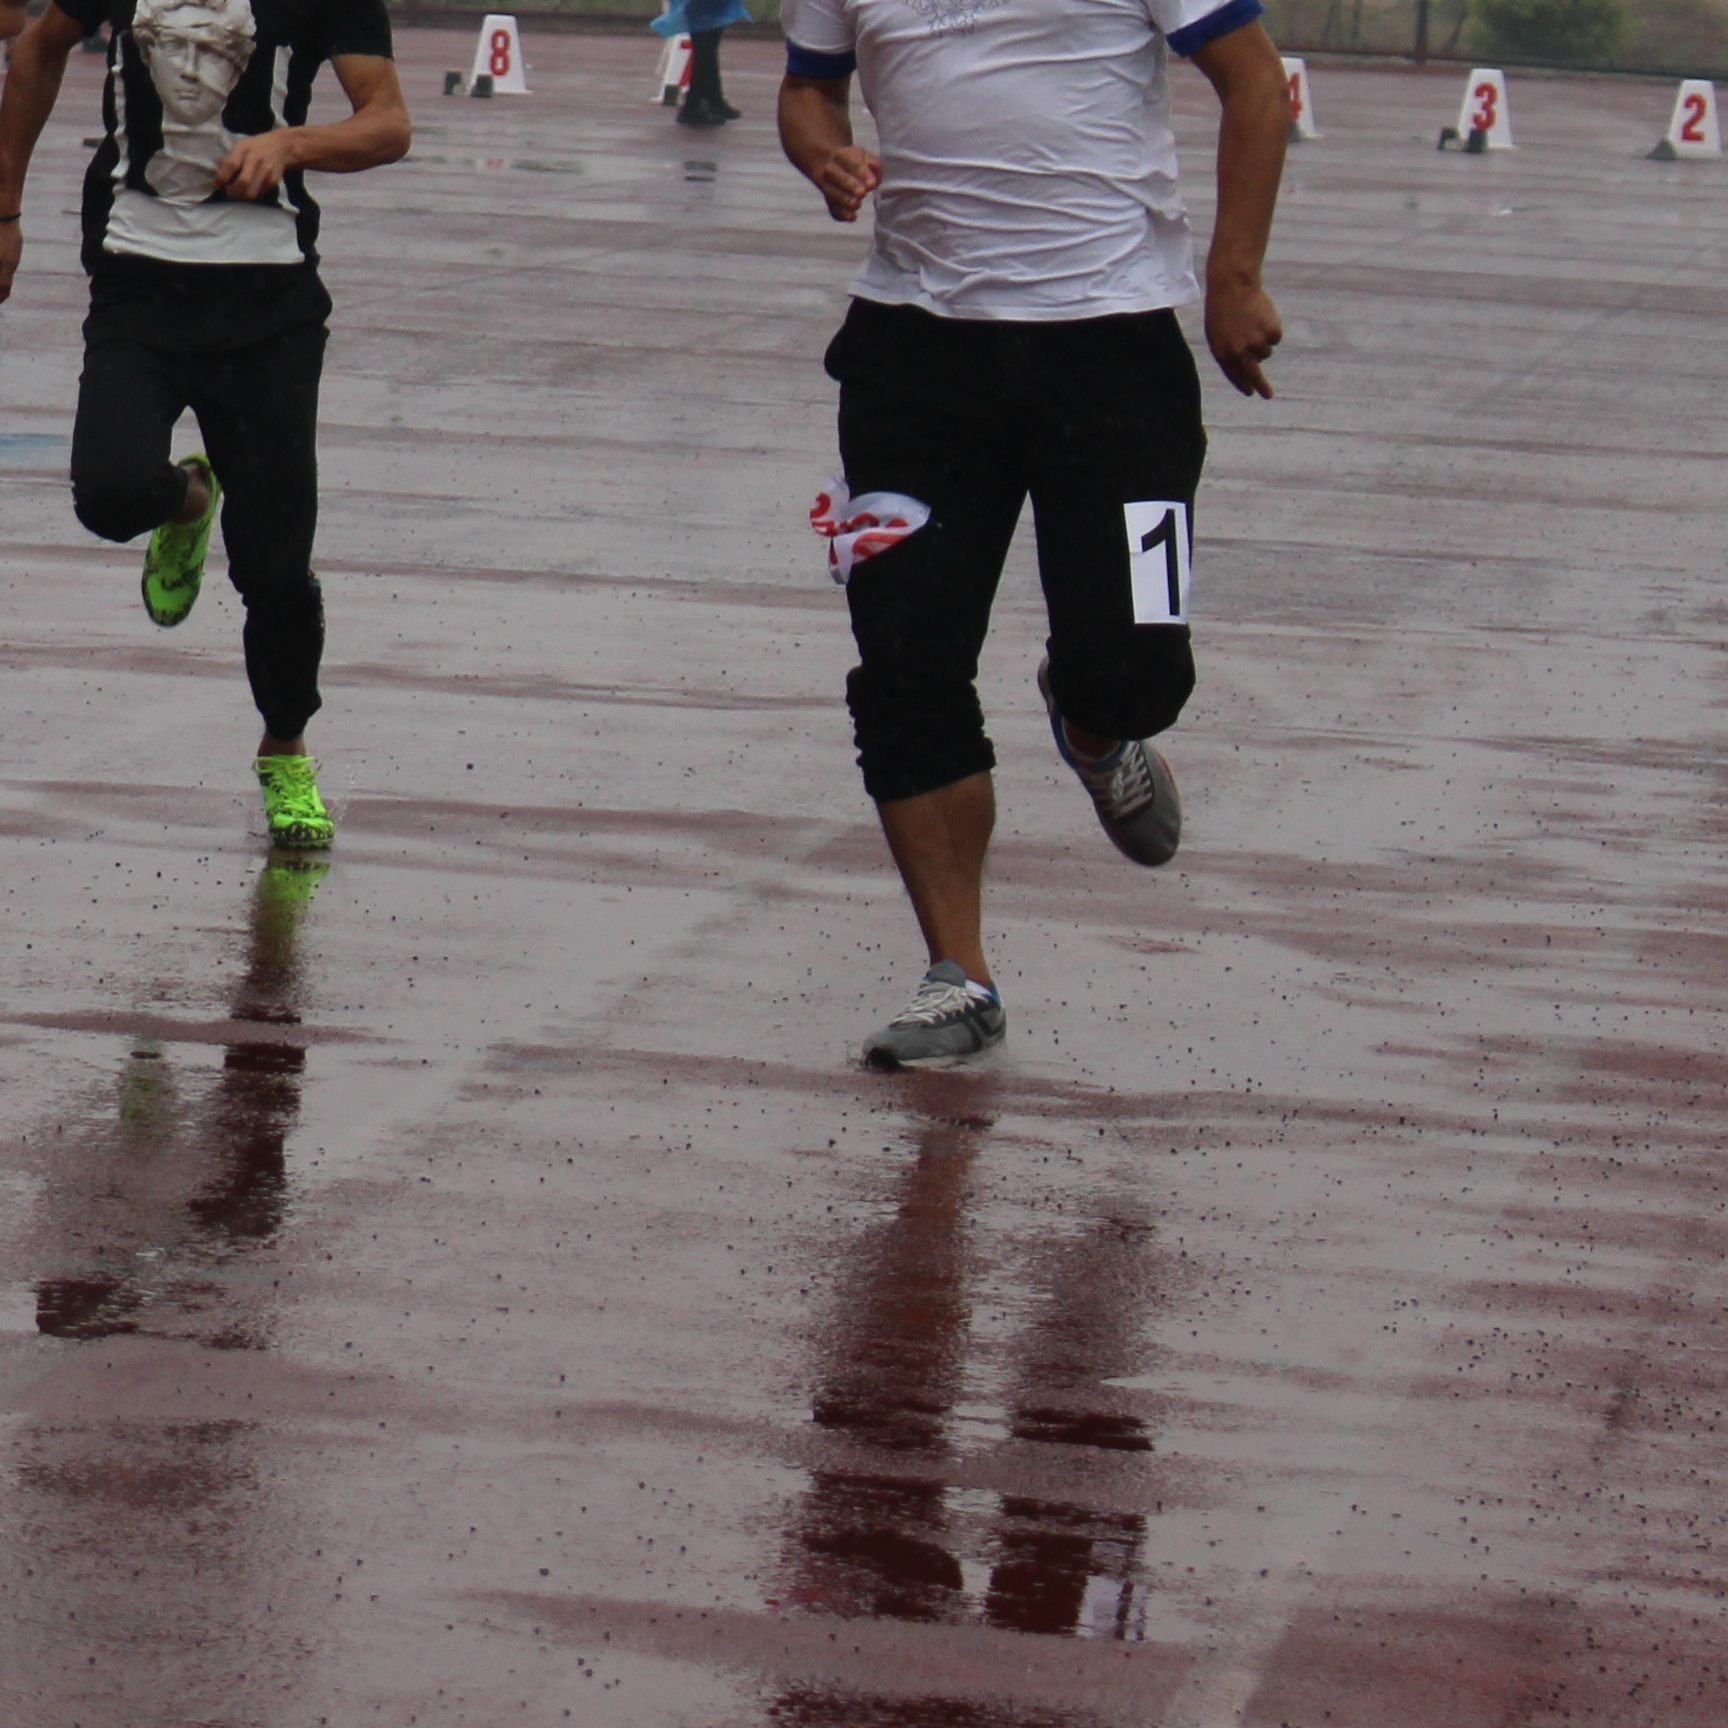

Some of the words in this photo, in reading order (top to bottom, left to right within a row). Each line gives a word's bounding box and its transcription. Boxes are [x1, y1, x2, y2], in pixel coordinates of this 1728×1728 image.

[489, 29, 511, 76] 8
[1288, 72, 1303, 121] 4
[1473, 82, 1497, 131] 3
[1682, 93, 1707, 141] 2
[1141, 508, 1180, 616] 1
